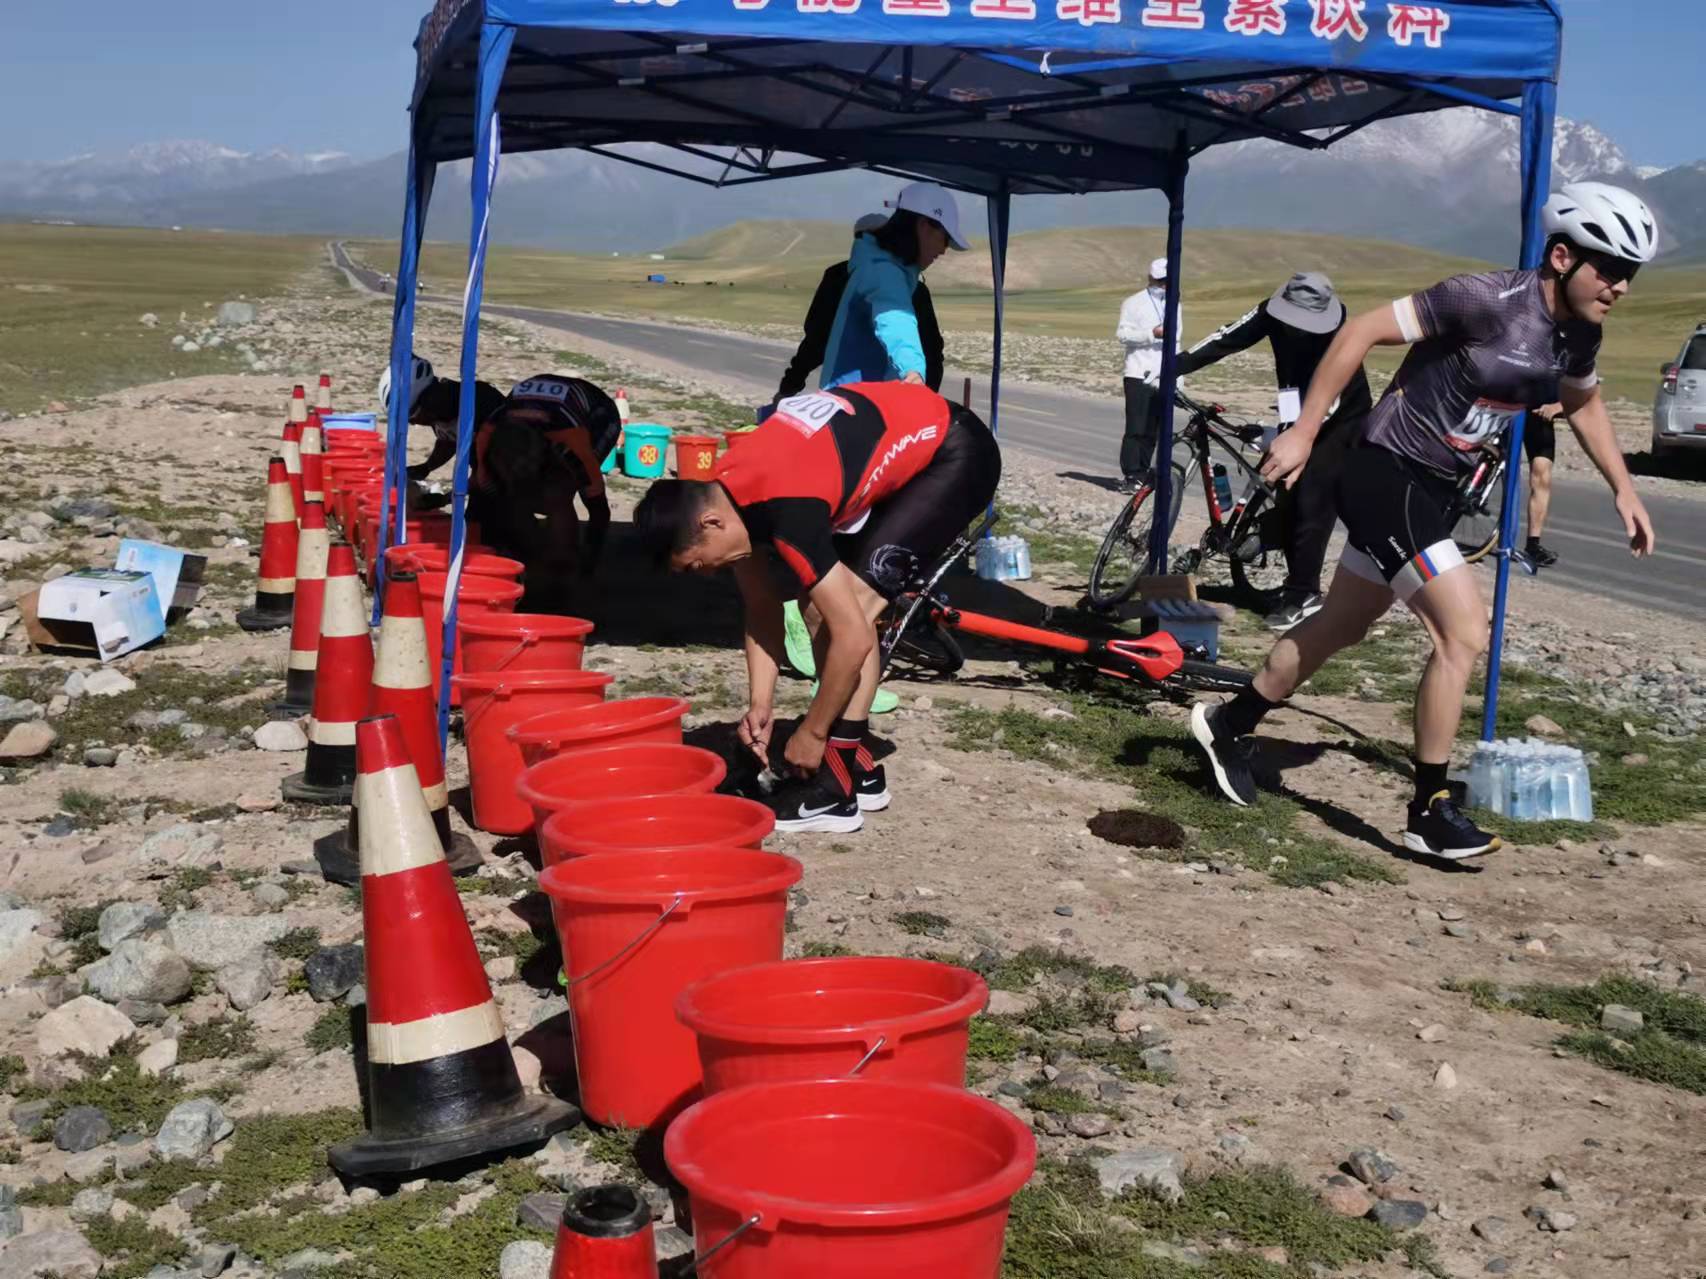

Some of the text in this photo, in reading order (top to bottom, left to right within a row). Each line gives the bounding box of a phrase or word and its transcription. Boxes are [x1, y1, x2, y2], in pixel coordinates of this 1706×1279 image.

[518, 381, 564, 396] 016
[640, 446, 657, 464] 38
[697, 451, 713, 470] 39
